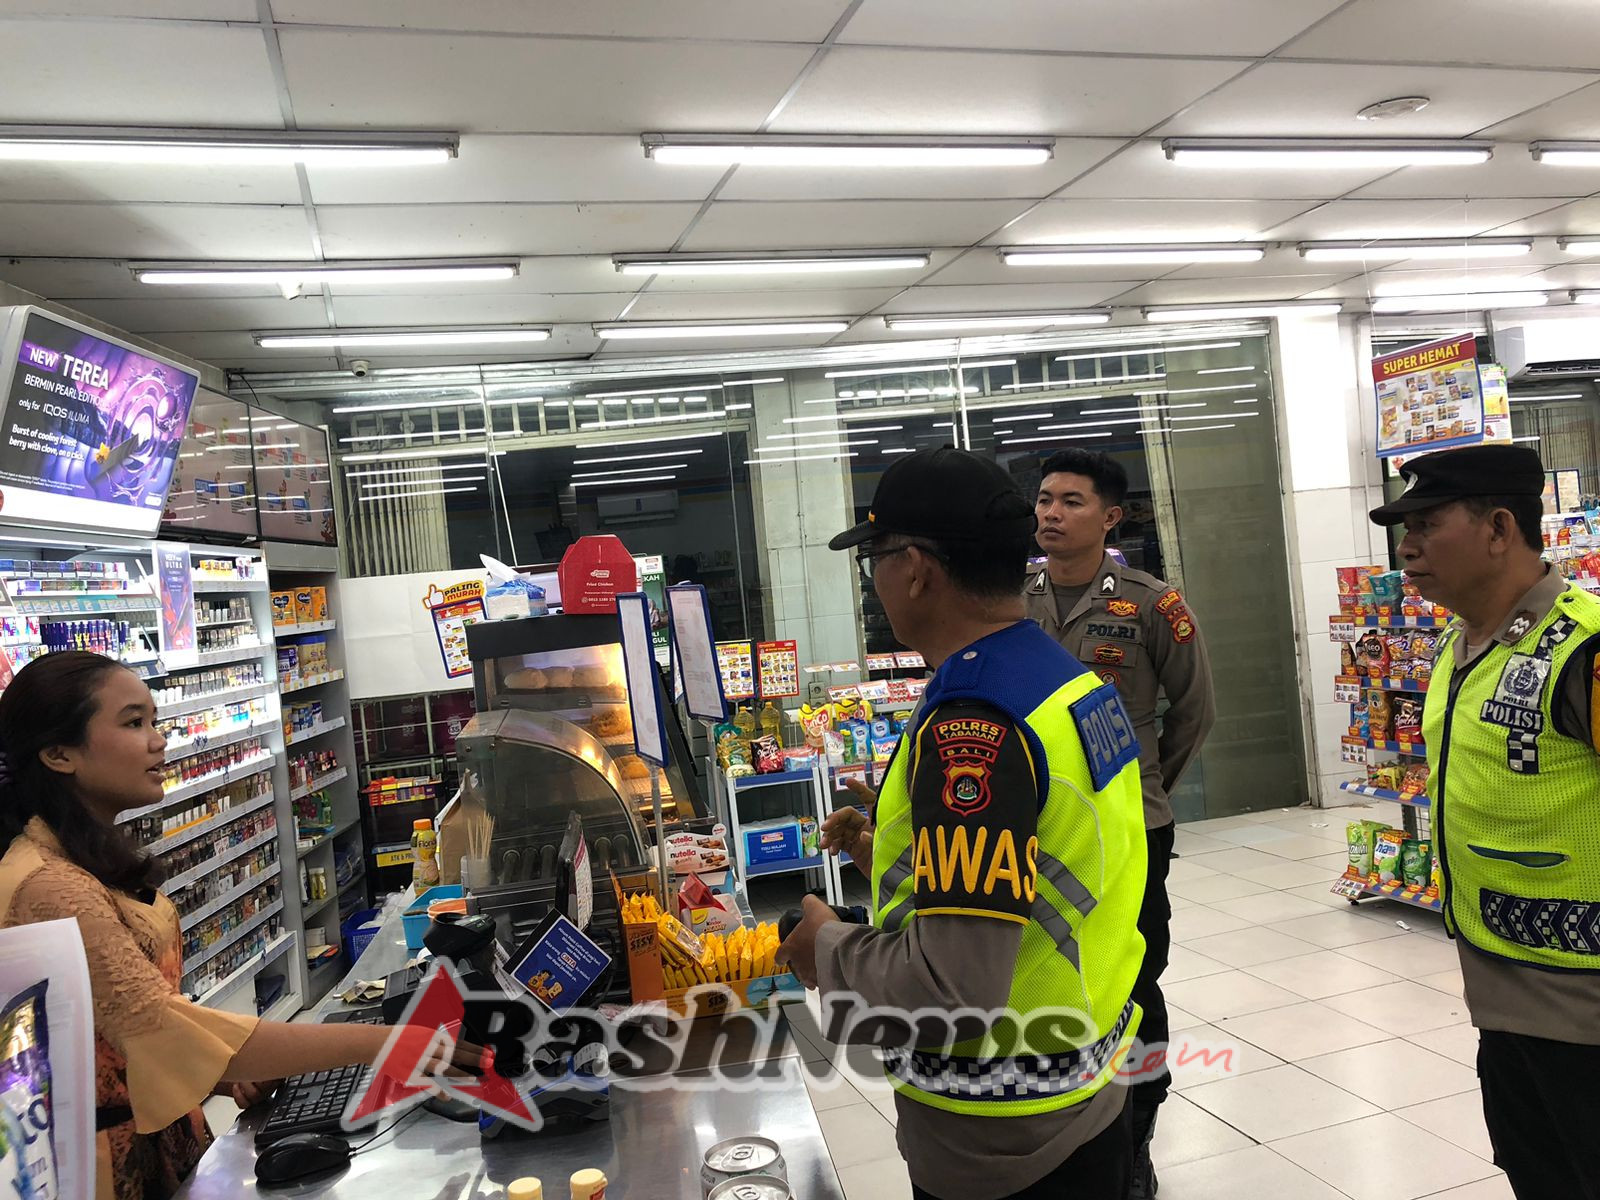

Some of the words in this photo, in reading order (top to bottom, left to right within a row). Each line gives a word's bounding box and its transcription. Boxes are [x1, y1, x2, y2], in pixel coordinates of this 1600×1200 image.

[1383, 355, 1418, 375] SUPER
[1420, 343, 1461, 365] HEMAT
[30, 348, 58, 368] NEW
[62, 354, 110, 391] TEREA
[54, 383, 77, 400] PEARL
[18, 399, 32, 411] only
[32, 401, 41, 410] for
[43, 403, 68, 419] IQOS
[12, 424, 30, 436] Burst
[30, 429, 39, 437] of
[38, 432, 60, 445] cooling
[9, 436, 27, 451] berry
[27, 441, 41, 451] with
[444, 582, 480, 596] PALING
[447, 589, 481, 601] MURAH
[1086, 623, 1137, 640] POLRI
[1502, 695, 1529, 707] POLRI
[1481, 701, 1541, 730] POLISI
[939, 721, 1000, 737] POLRES
[943, 730, 996, 742] TABANAN
[1081, 695, 1136, 775] POLISI
[946, 747, 990, 758] BALI
[670, 849, 697, 859] nutella
[912, 825, 1038, 903] AWAS
[560, 952, 576, 967] CINTA
